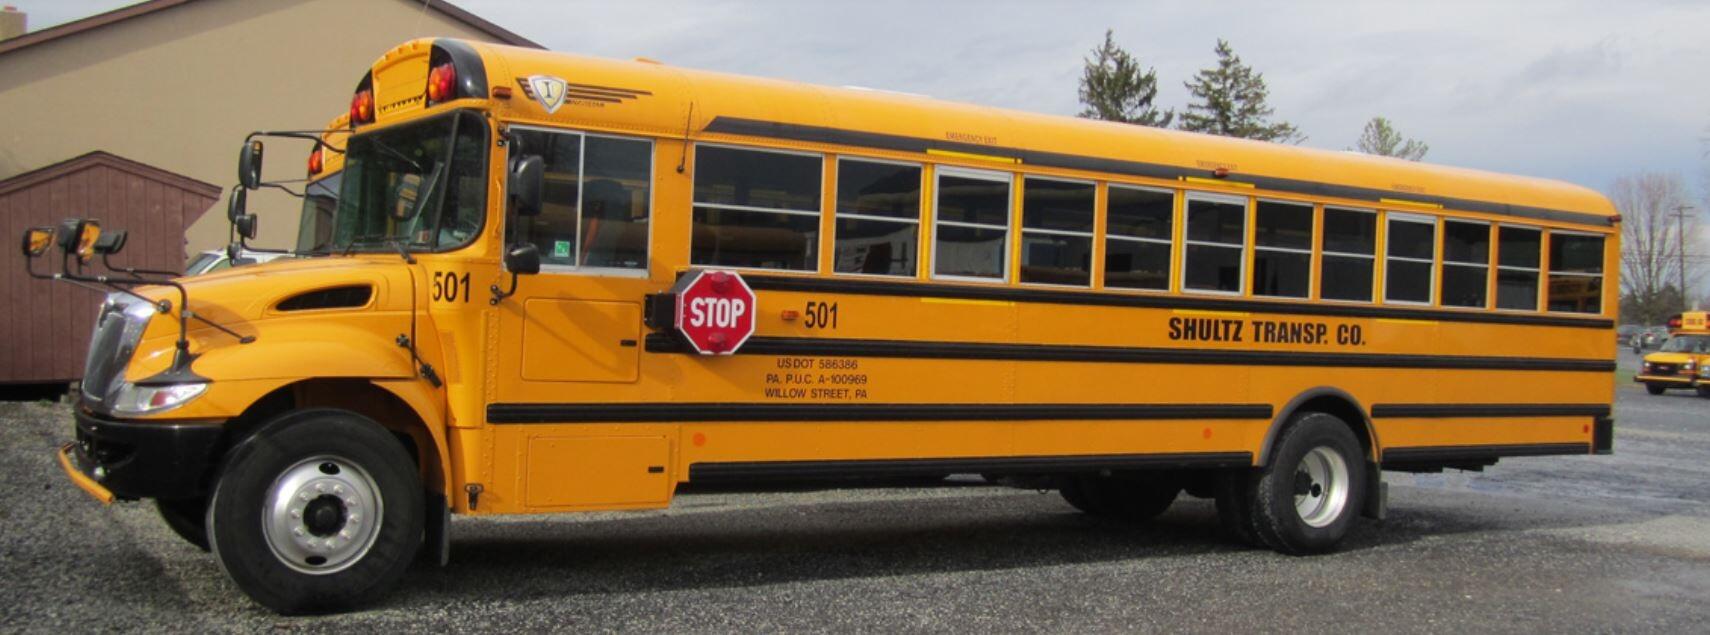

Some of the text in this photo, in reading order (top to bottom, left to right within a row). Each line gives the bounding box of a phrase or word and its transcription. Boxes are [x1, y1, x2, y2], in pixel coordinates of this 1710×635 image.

[432, 271, 470, 302] 501
[690, 297, 745, 328] STOP
[804, 301, 838, 329] 501
[1168, 317, 1366, 346] SHULTZ TRANSP. CO.
[764, 387, 807, 398] WILLOW
[855, 389, 868, 399] PA
